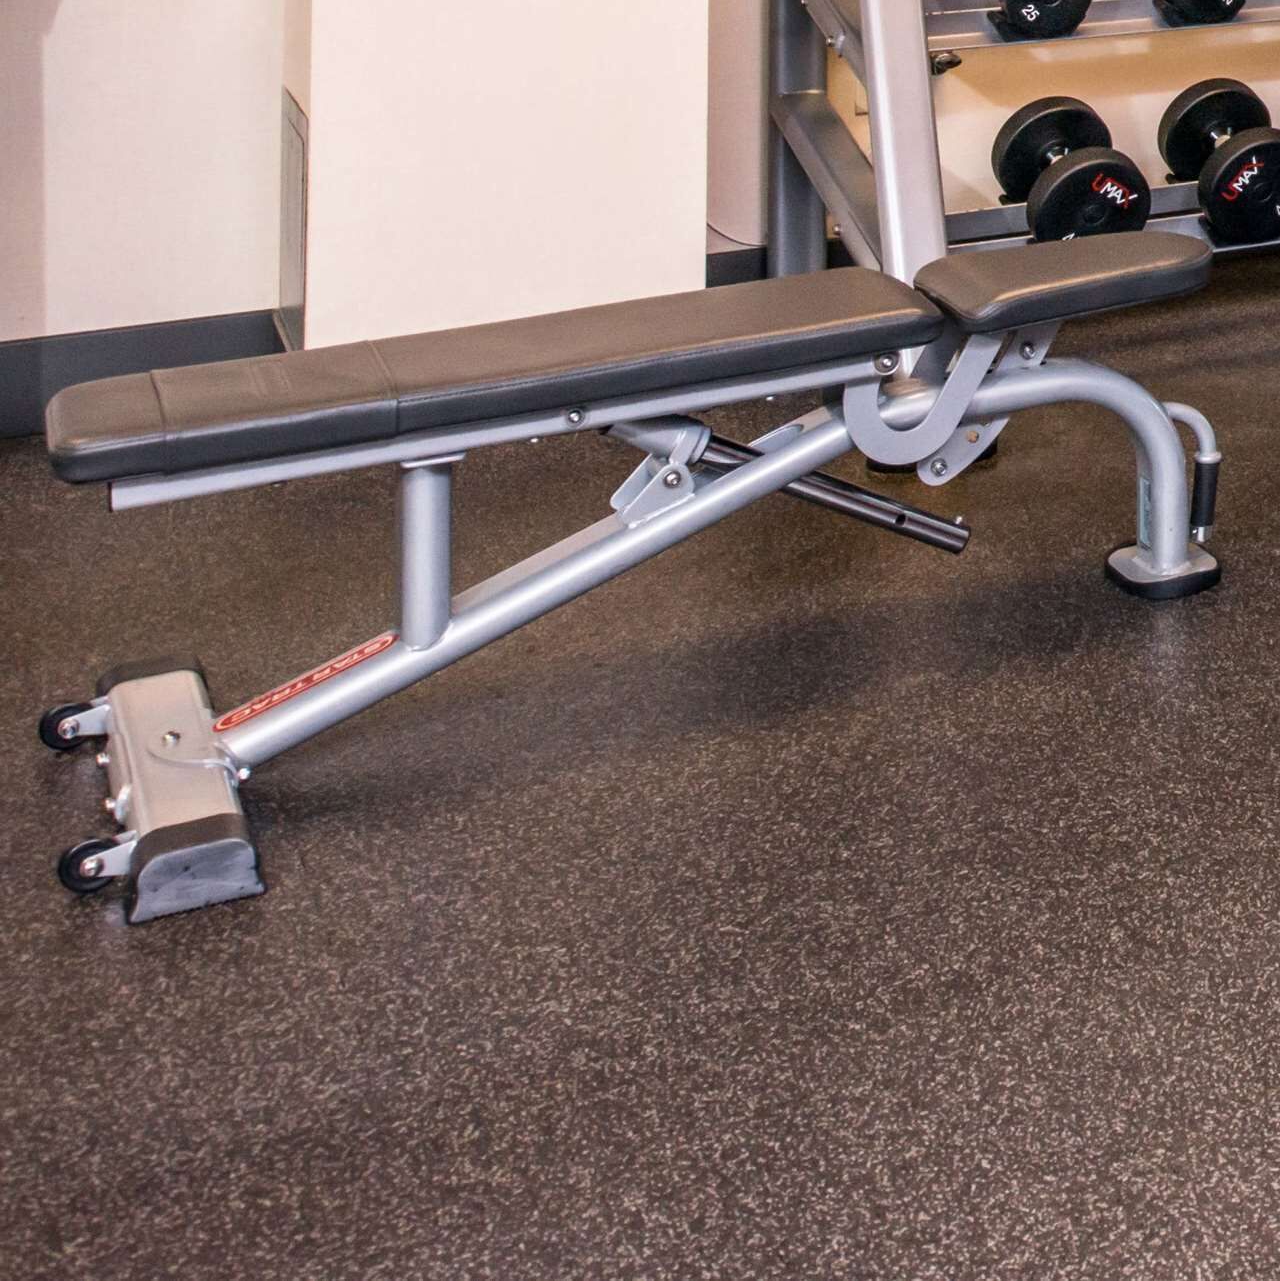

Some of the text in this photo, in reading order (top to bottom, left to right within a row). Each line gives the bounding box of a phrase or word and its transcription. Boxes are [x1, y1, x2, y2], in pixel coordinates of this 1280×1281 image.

[1021, 4, 1040, 21] 25
[1091, 173, 1138, 209] UMAX
[1221, 155, 1265, 202] UMAX
